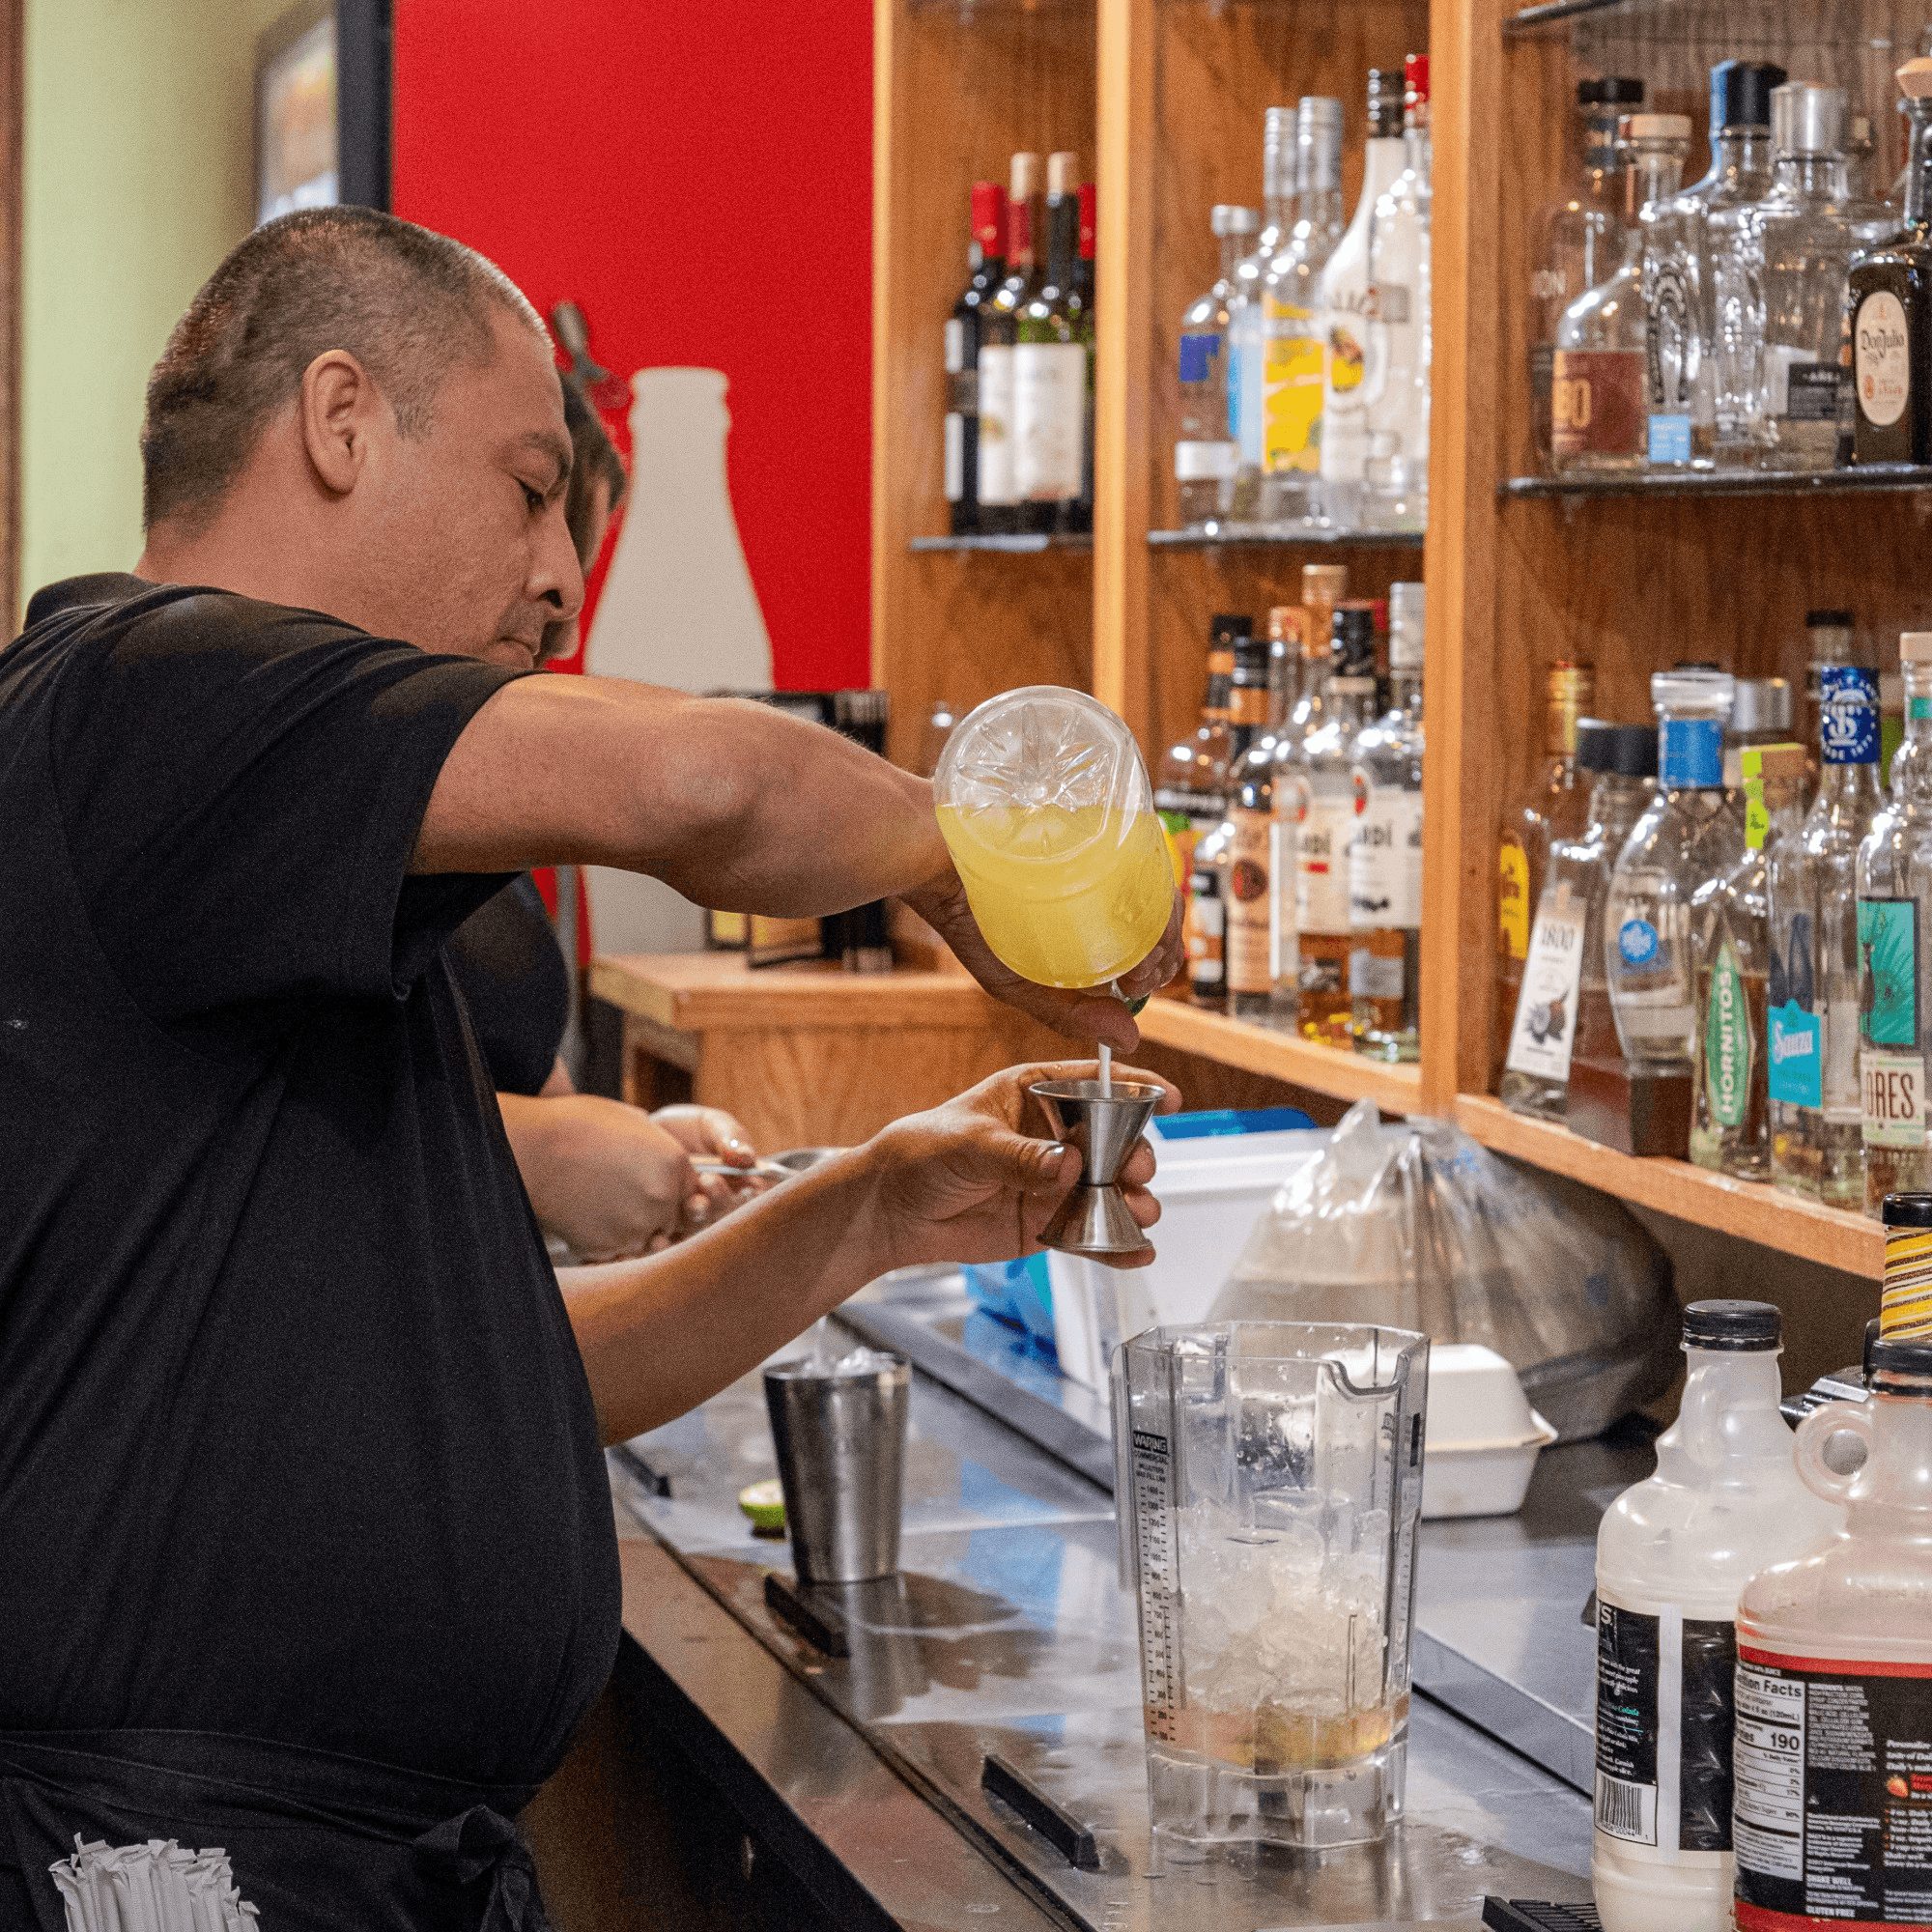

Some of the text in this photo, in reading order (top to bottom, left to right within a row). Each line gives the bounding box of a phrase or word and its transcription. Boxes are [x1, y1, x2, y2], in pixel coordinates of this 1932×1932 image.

[1719, 970, 1734, 1114] HORNITOS
[1772, 1020, 1814, 1065] Sauza
[1134, 1433, 1167, 1453] WARING
[1132, 1450, 1169, 1465] COMMERCIAL
[1147, 1485, 1159, 1495] 1400
[1148, 1501, 1159, 1511] 1300
[1149, 1518, 1160, 1527] 1200
[1149, 1535, 1160, 1545] 1100
[1764, 1679, 1802, 1697] Facts
[1771, 1732, 1800, 1750] 190
